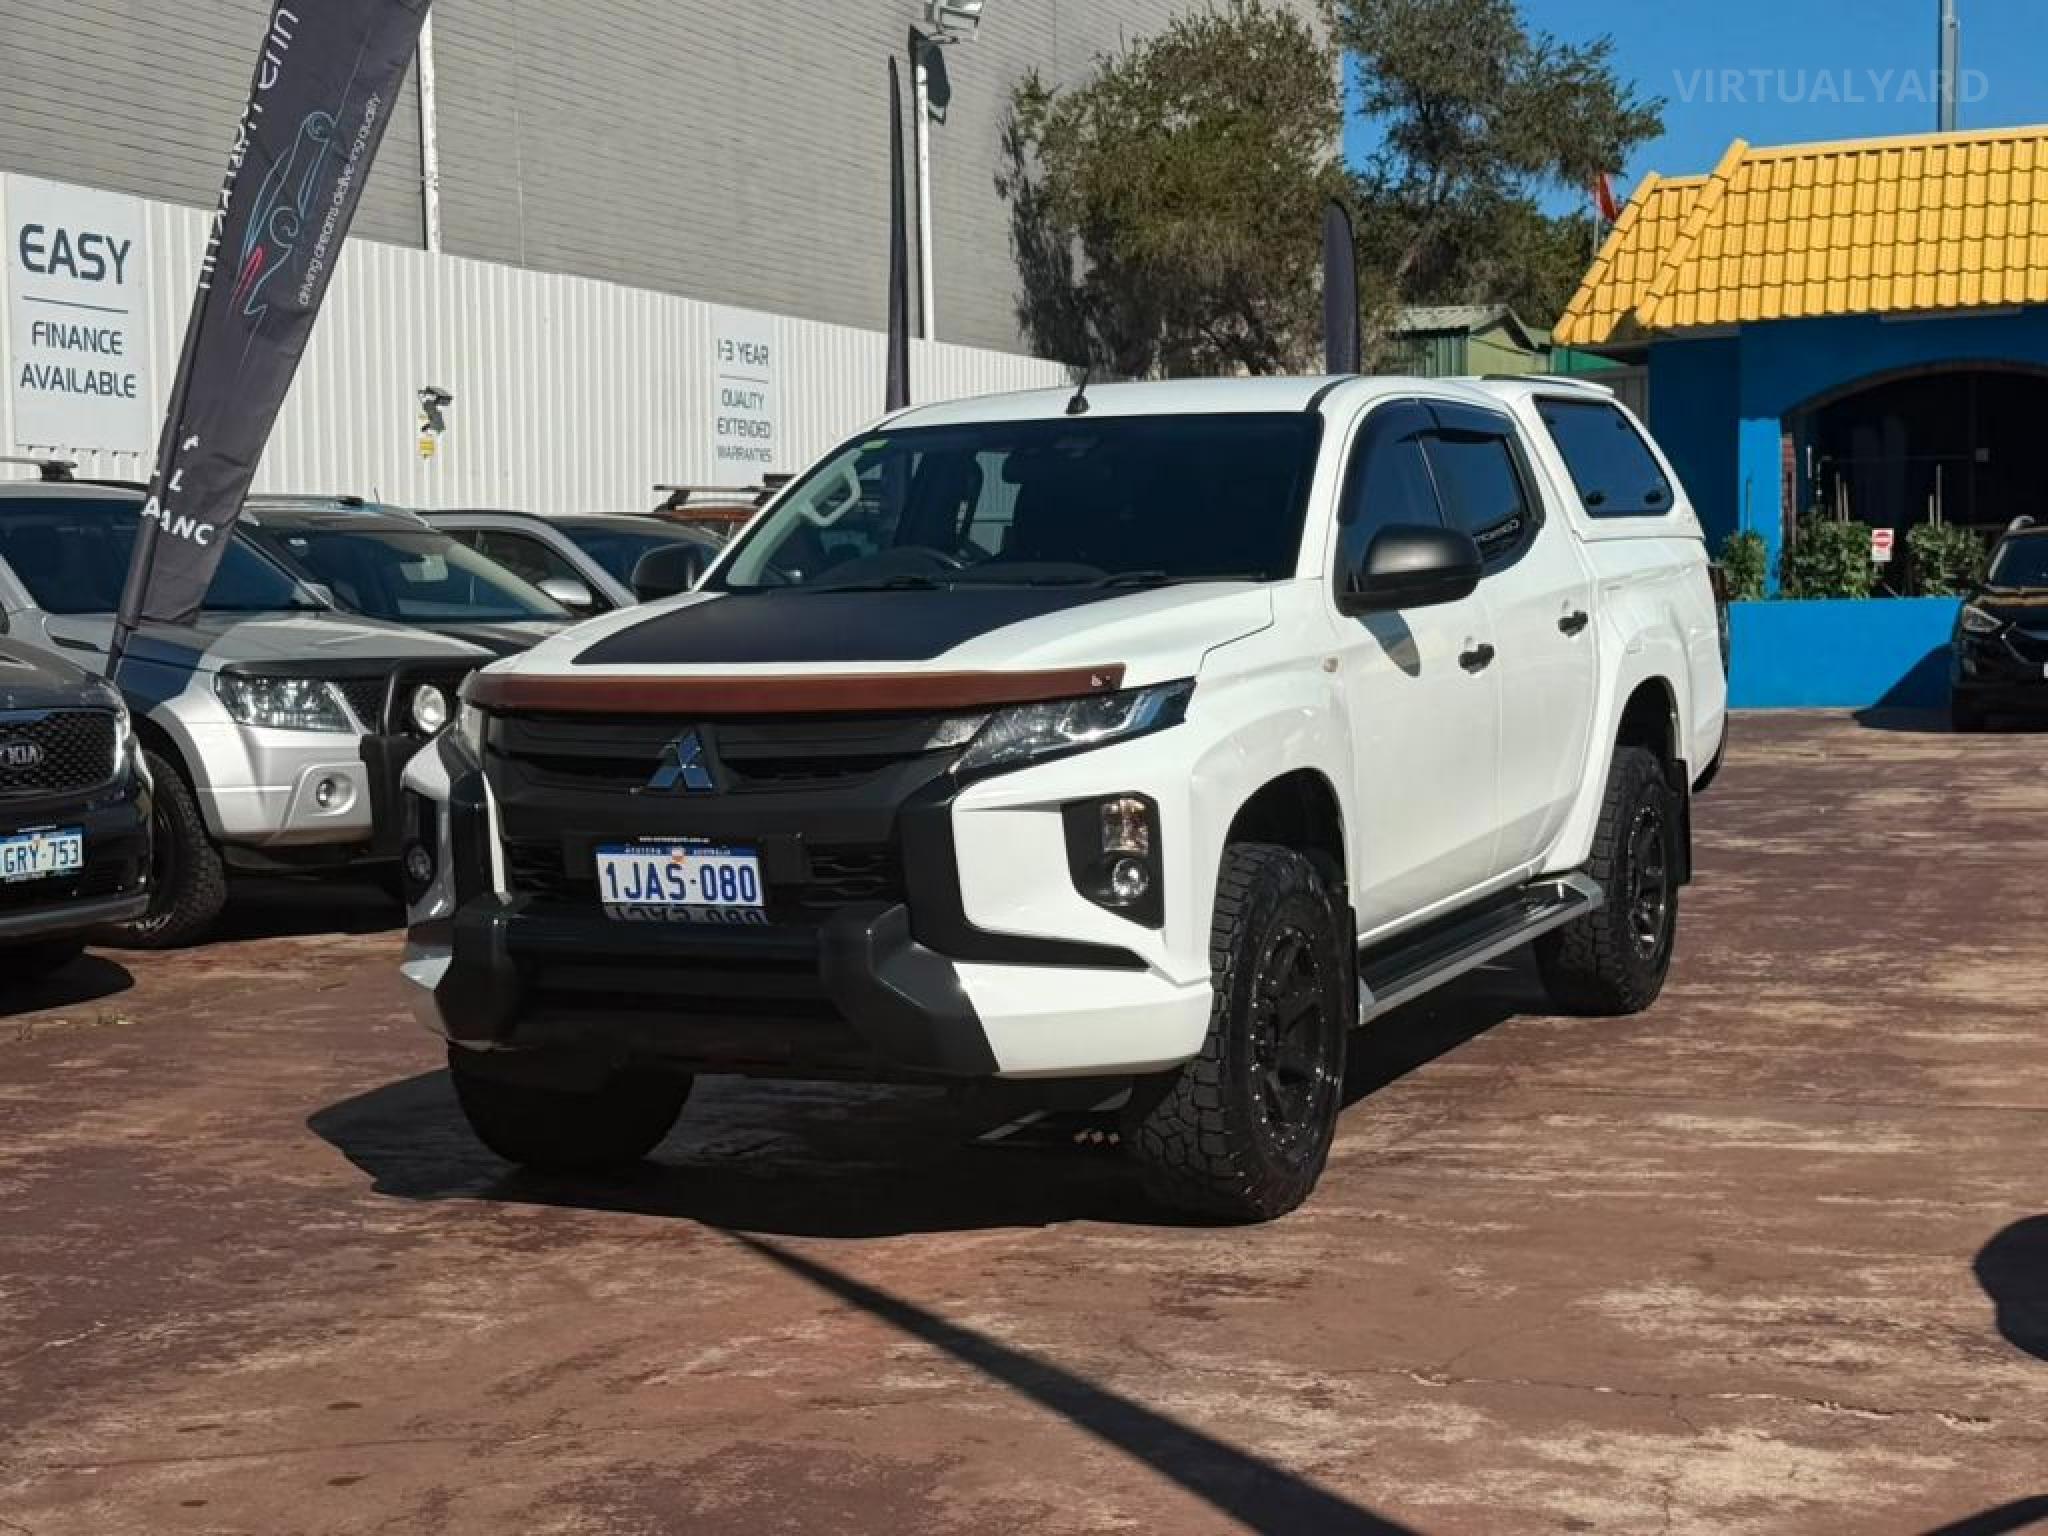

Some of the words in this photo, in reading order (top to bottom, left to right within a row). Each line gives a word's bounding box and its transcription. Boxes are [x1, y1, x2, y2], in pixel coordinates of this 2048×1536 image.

[19, 223, 132, 284] EASY
[31, 319, 124, 355] FINANCE
[736, 340, 769, 367] YEAR
[19, 362, 137, 398] AVAILABLE
[721, 387, 764, 410] QUALITY
[717, 416, 771, 439] EXTENDED
